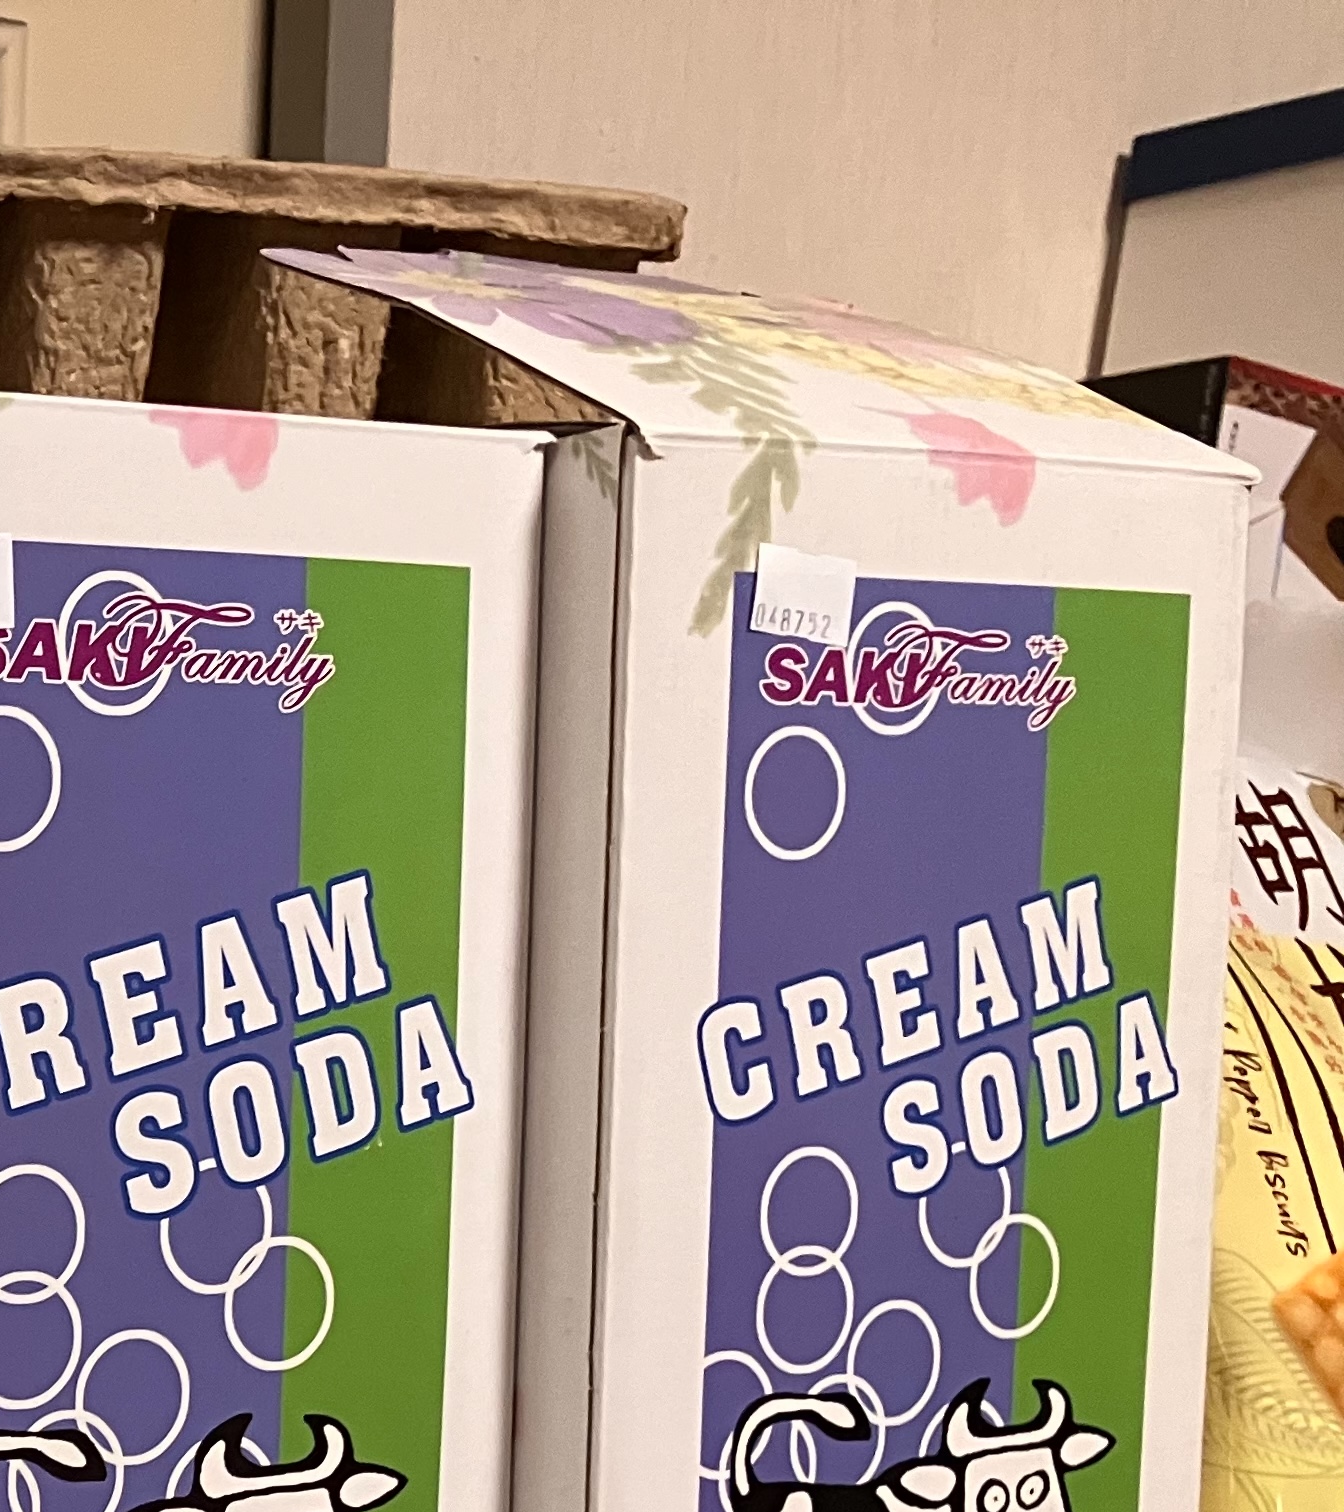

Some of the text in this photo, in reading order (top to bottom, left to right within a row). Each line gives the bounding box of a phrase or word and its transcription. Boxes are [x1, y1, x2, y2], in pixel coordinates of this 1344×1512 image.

[104, 593, 333, 712] Family
[274, 608, 323, 634] サキ
[761, 622, 1076, 731] SAKI Family
[698, 876, 1113, 1122] CREAM
[113, 998, 474, 1217] SODA
[880, 992, 1179, 1198] SODA
